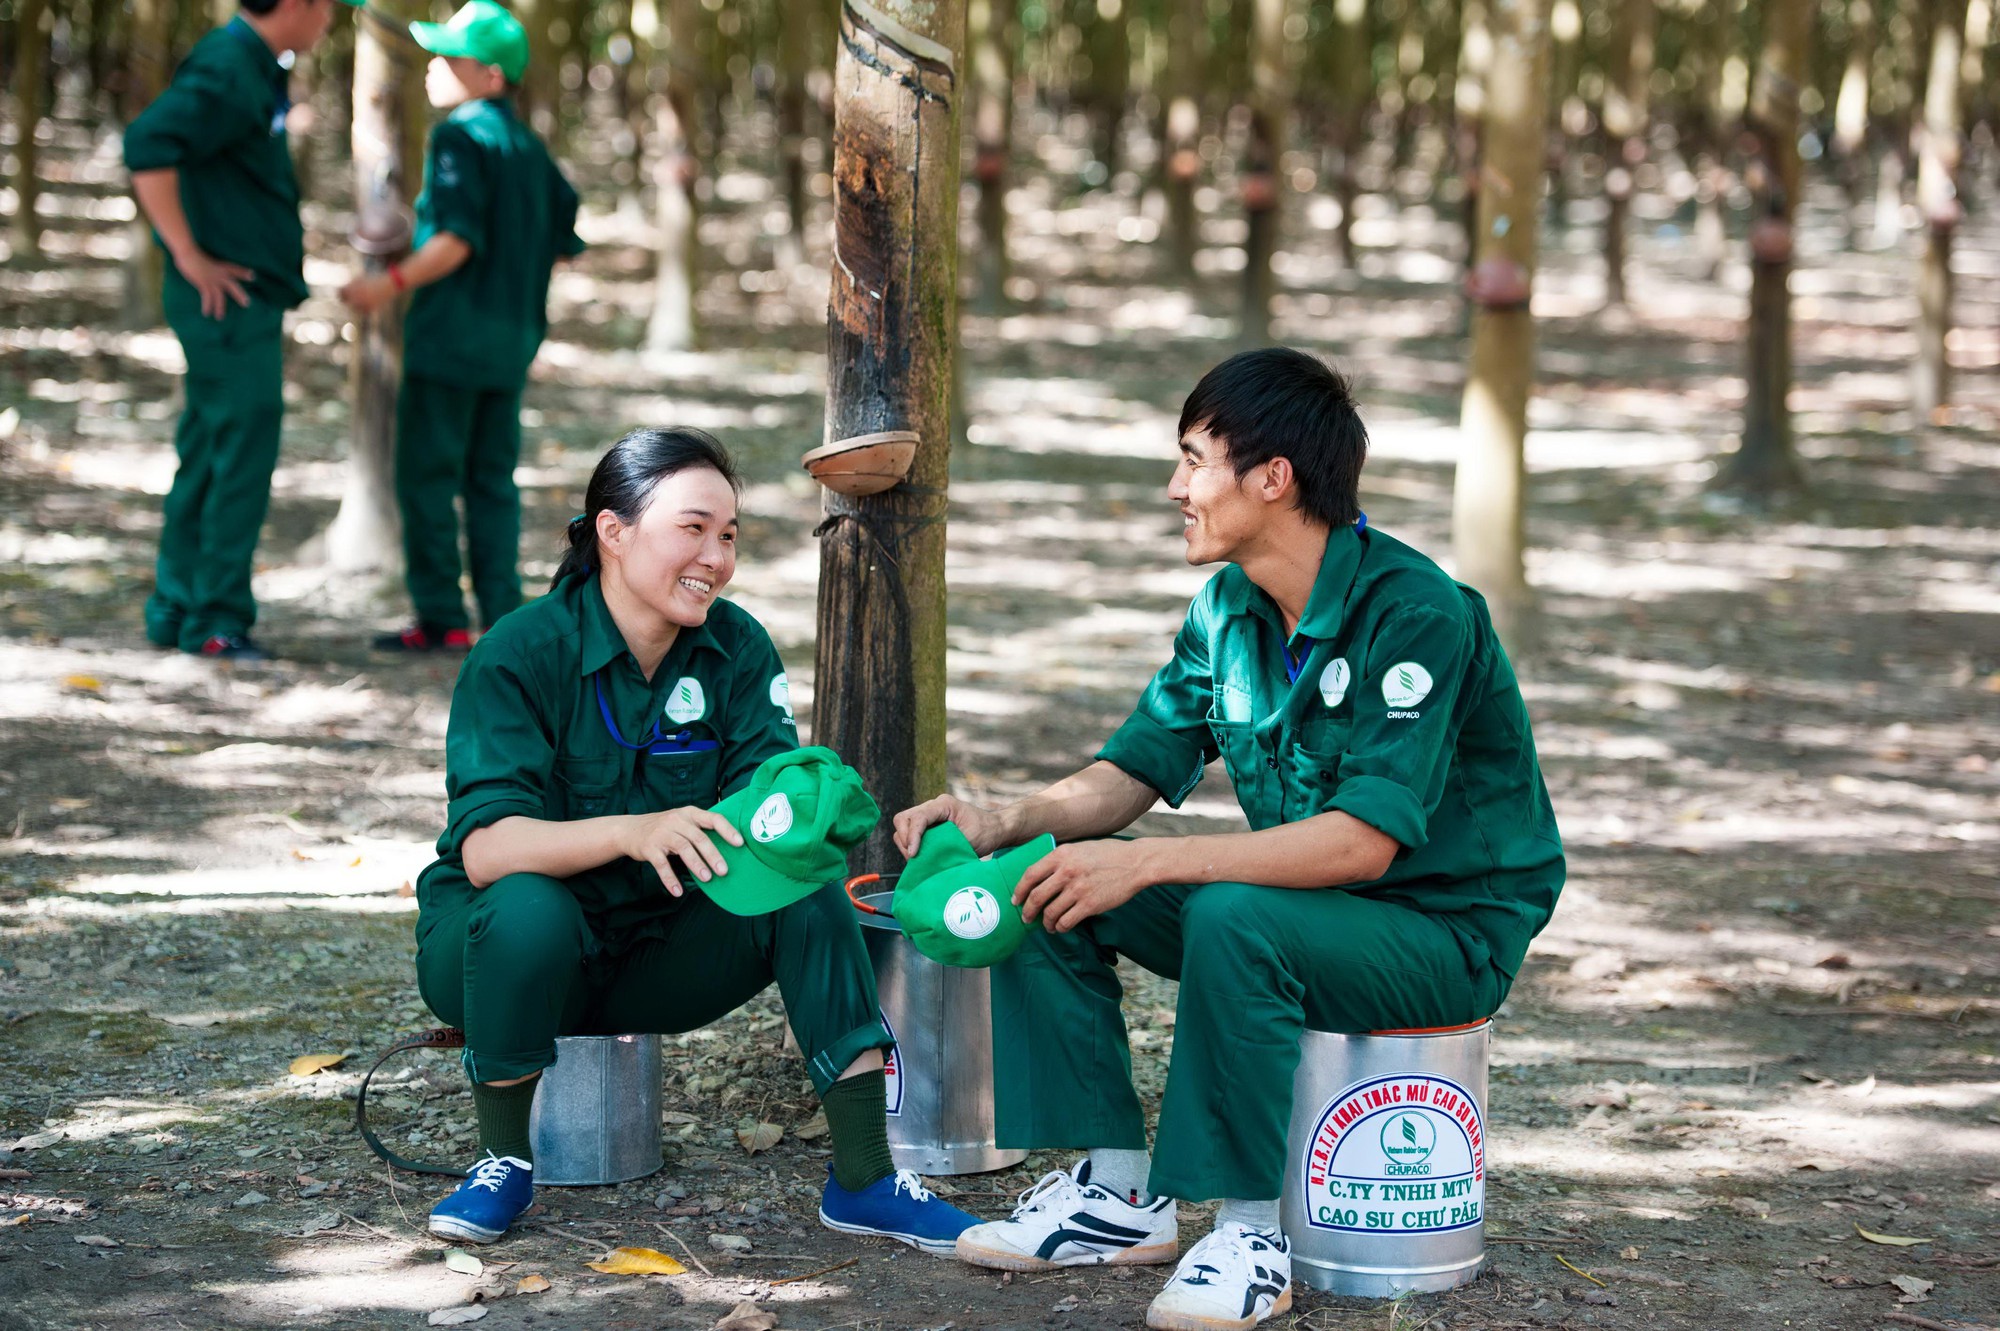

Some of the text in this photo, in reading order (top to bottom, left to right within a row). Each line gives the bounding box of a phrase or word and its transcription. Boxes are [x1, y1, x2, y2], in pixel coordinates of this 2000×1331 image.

[1387, 711, 1420, 719] CHUPACO
[1332, 1098, 1364, 1130] KHAI
[1362, 1083, 1402, 1110] THÁC
[1406, 1079, 1430, 1103] MỦ
[1432, 1087, 1458, 1112] CAO
[1455, 1101, 1471, 1123] SU
[1387, 1165, 1430, 1175] CHUPACO
[1329, 1177, 1474, 1201] C.TY TNHH MTV
[1319, 1201, 1478, 1229] CAO SU CHƯ PĂH
